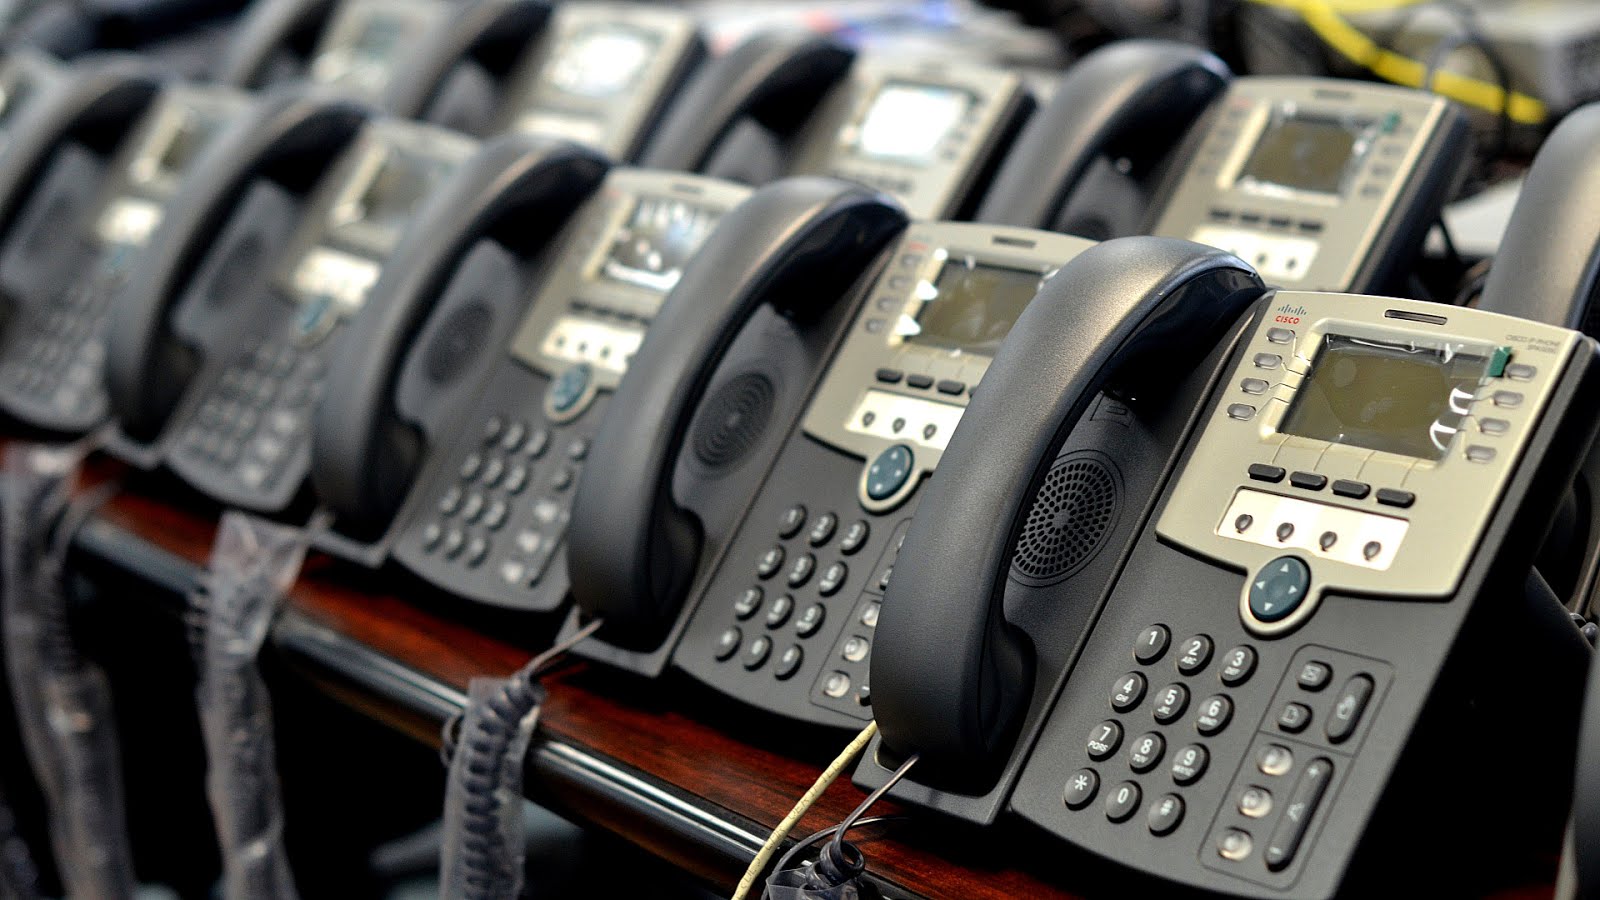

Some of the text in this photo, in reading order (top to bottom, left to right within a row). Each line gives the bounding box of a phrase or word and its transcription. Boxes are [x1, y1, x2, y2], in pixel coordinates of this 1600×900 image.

[1275, 315, 1300, 325] CISCO
[1148, 630, 1158, 646] 1
[1187, 640, 1202, 656] 2
[1231, 650, 1246, 667] 3
[1122, 678, 1135, 694] 4
[1164, 689, 1178, 706] 5
[1208, 700, 1222, 717] 6
[1099, 726, 1112, 741] 7
[1140, 738, 1154, 755] 8
[1183, 749, 1197, 766] 9
[1117, 787, 1129, 804] 0
